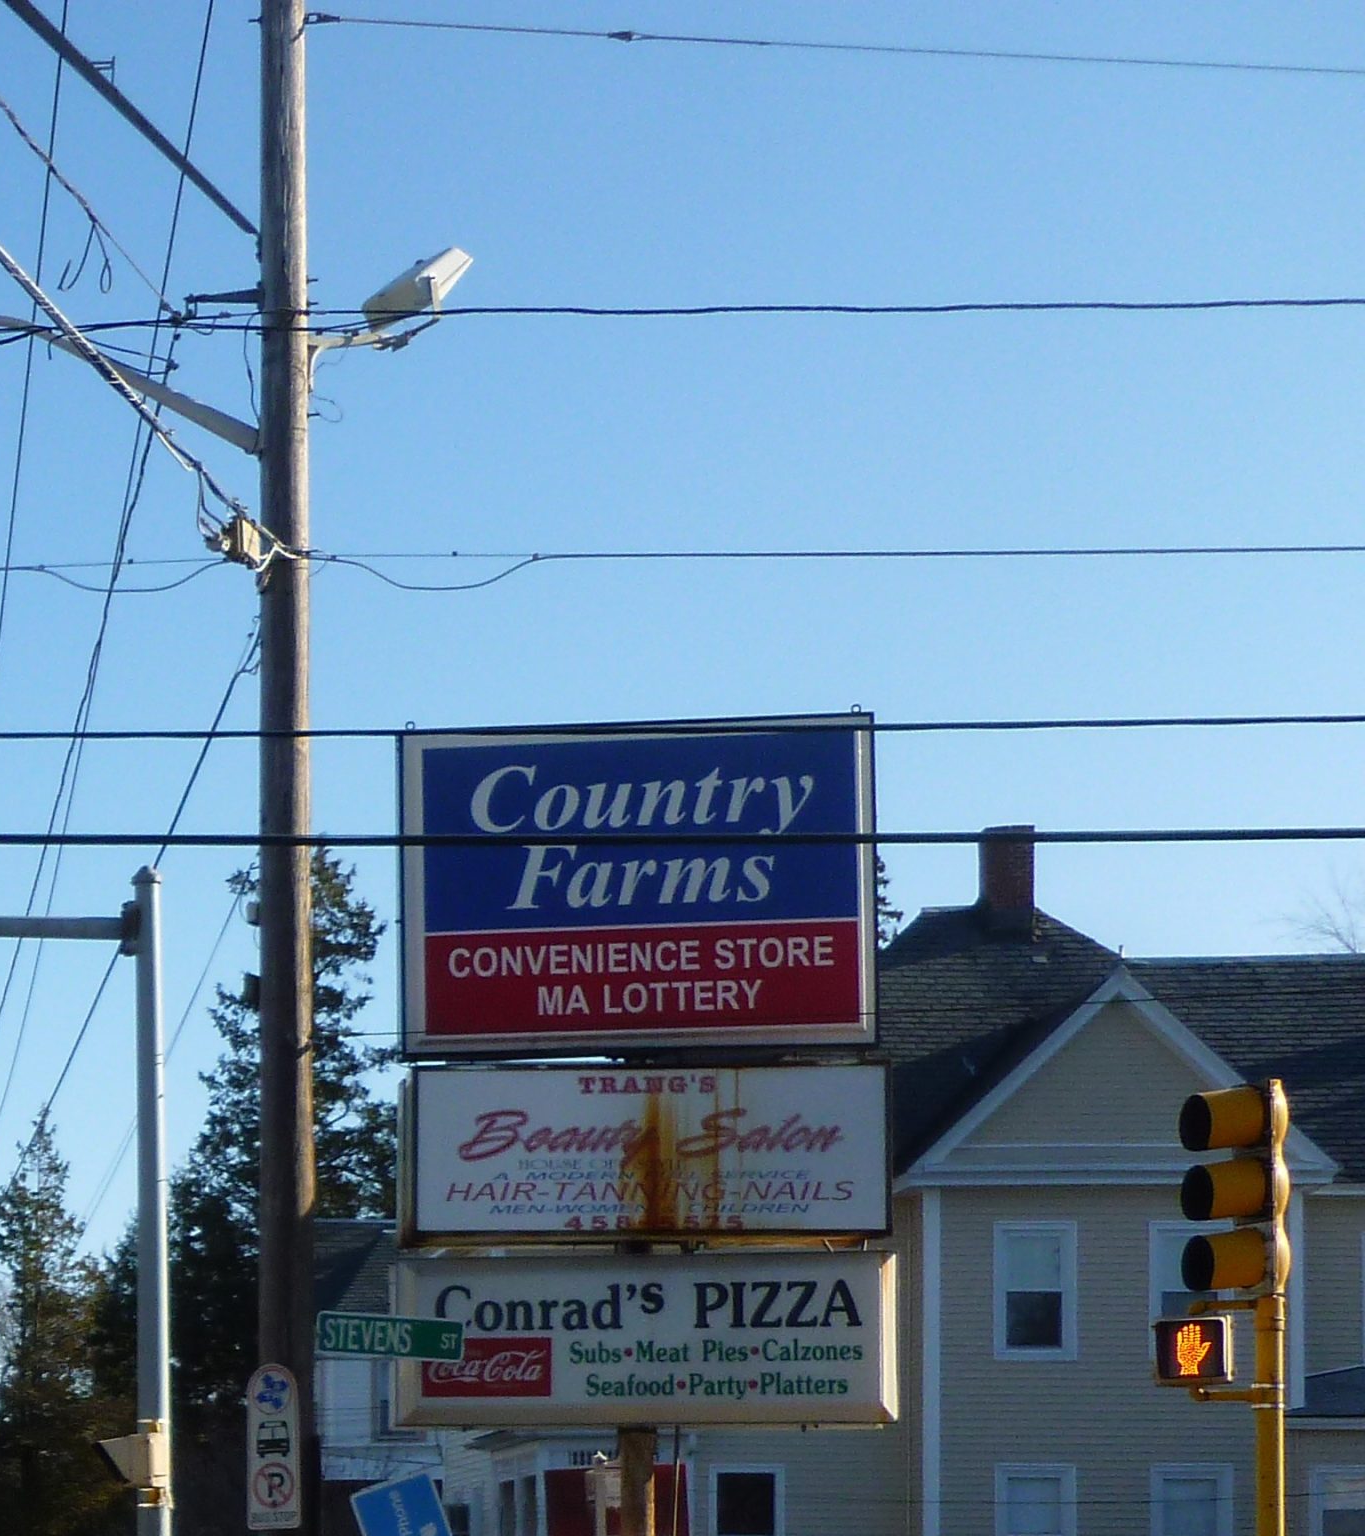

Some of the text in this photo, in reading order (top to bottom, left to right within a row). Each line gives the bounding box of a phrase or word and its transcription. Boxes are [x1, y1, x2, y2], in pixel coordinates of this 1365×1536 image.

[469, 763, 814, 836] Country
[505, 842, 776, 911] Farms
[447, 935, 835, 979] CONVENIENCE STORE
[536, 978, 765, 1017] MA LOTTERY
[578, 1075, 716, 1095] TRANG'S
[676, 1107, 844, 1159] Salon
[525, 1170, 634, 1181] MODERN
[434, 1278, 863, 1332] Conrad's PIZZA
[323, 1317, 458, 1354] STEVENS ST
[569, 1338, 863, 1365] Subs Meat Pies Calzones
[585, 1372, 849, 1400] Seafood Party Platters
